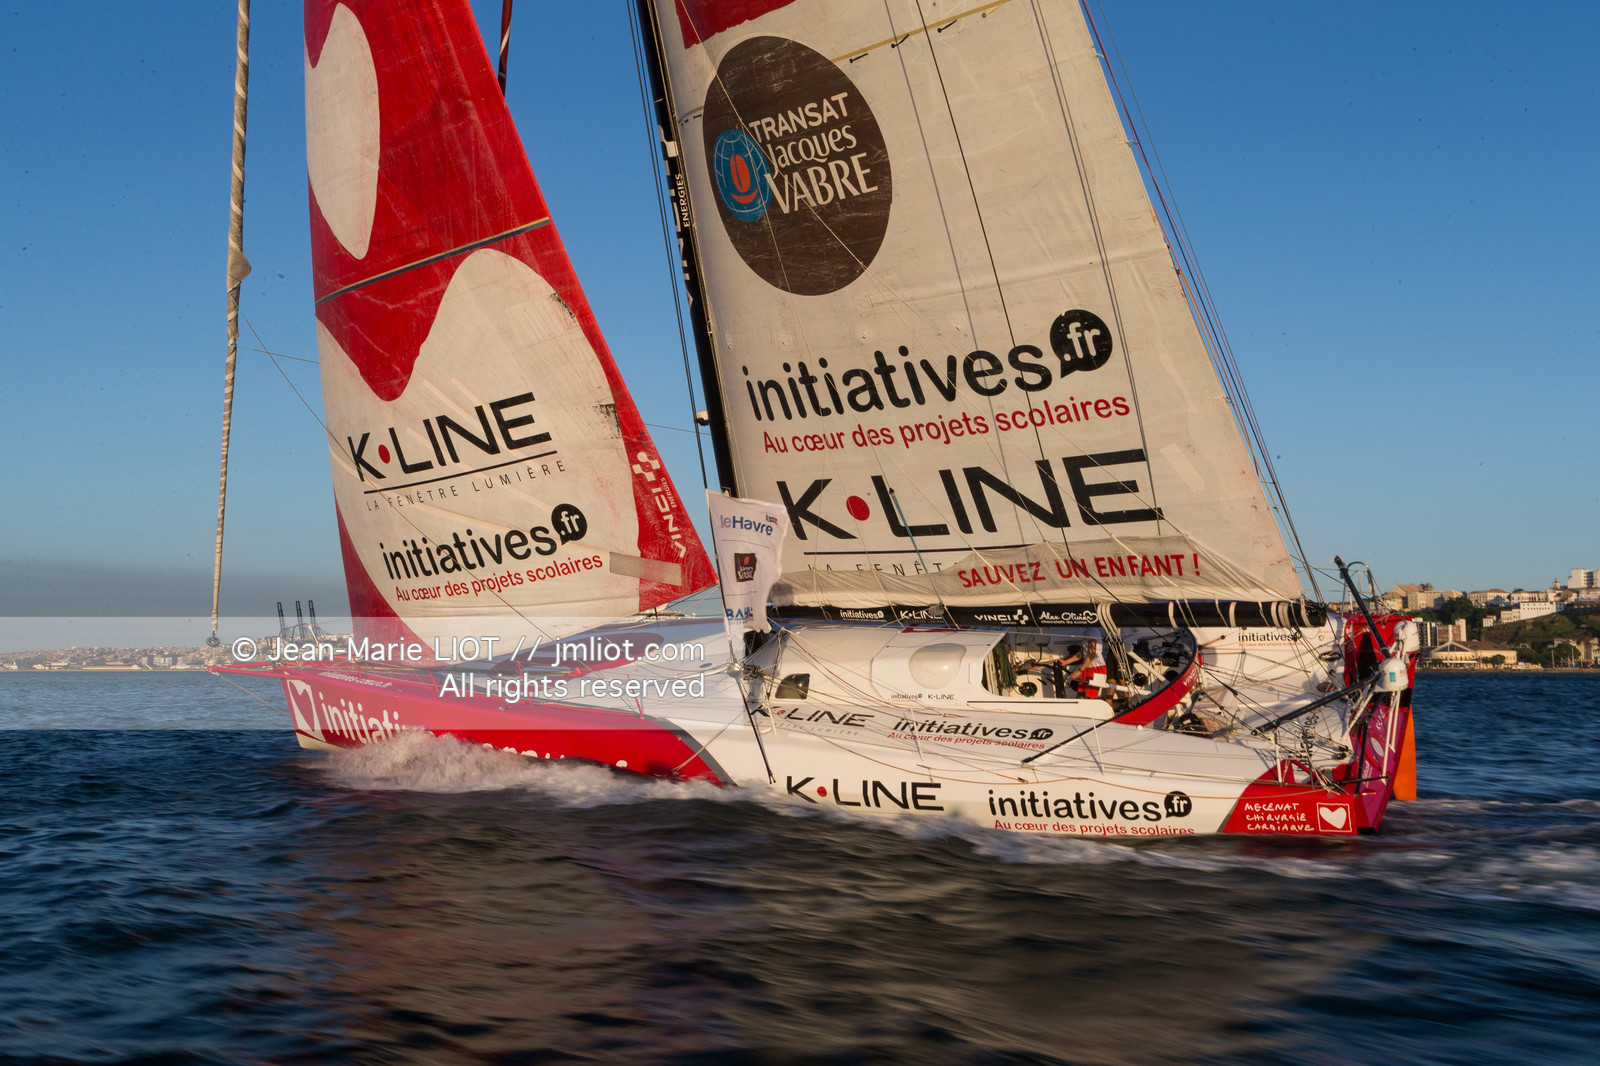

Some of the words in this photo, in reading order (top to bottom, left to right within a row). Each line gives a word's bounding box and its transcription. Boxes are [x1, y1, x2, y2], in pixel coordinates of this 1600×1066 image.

[749, 92, 848, 143] TRANSAT
[767, 125, 857, 178] Jacques
[674, 173, 691, 228] ENERGIES
[764, 152, 878, 214] VABRE
[763, 431, 789, 455] Au
[853, 424, 895, 449] des
[899, 411, 990, 449] projets
[994, 395, 1131, 432] scolaires
[366, 499, 380, 511] LA
[471, 460, 566, 492] LUMIÈRE
[660, 477, 677, 508] ENERGIES
[396, 586, 410, 602] Au
[445, 580, 470, 597] des
[471, 570, 524, 597] projets
[528, 554, 603, 582] scolaires
[957, 561, 1046, 588] SAUVEZ
[1055, 557, 1091, 580] UN
[1094, 554, 1185, 578] ENFANT
[1039, 611, 1060, 620] Alex
[933, 735, 953, 743] des
[954, 737, 992, 747] projets
[994, 739, 1045, 749] scolaires
[994, 819, 1012, 830] Au
[1052, 821, 1077, 833] des
[1080, 824, 1129, 836] projets
[1131, 826, 1195, 836] scolaires
[1244, 803, 1300, 812] MECENAT
